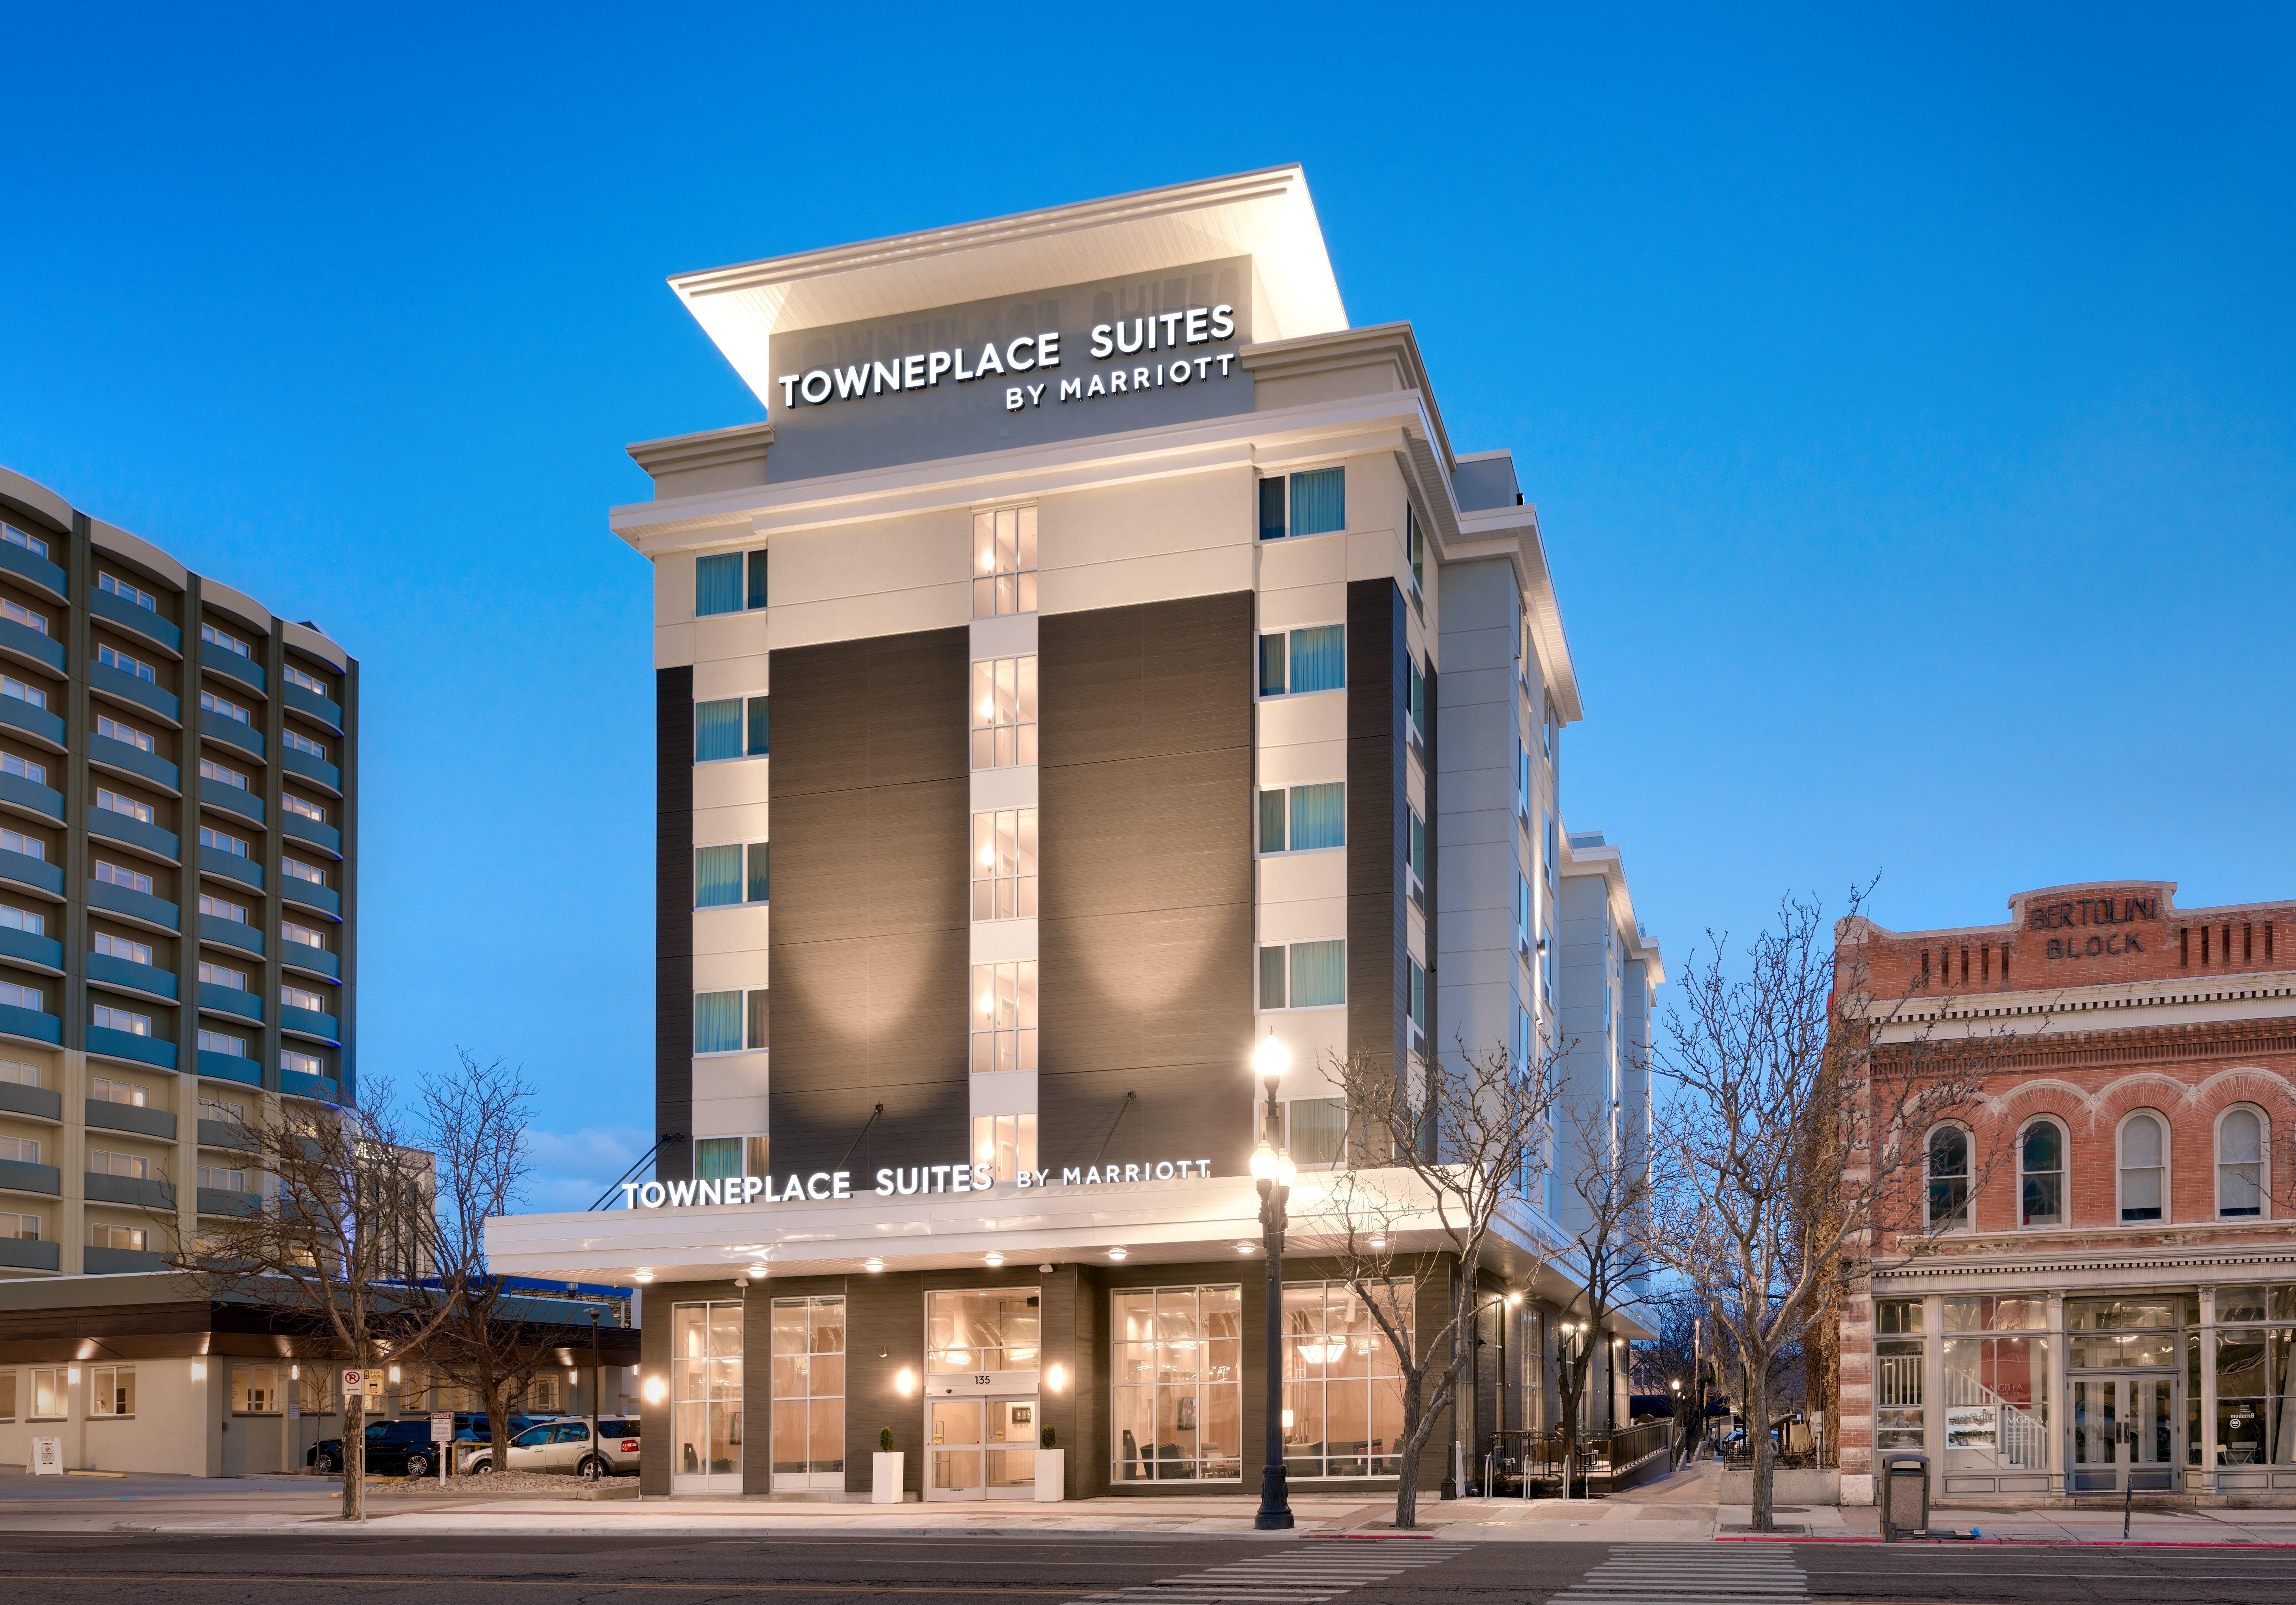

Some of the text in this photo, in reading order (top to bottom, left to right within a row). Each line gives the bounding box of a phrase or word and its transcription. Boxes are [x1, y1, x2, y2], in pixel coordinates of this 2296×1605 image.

[778, 304, 1234, 407] TOWNEPLACE SUITES
[1006, 353, 1235, 411] BY MARRIOTT
[2032, 898, 2156, 930] BERTOLINI
[2048, 932, 2144, 959] BLOCK
[622, 1159, 1211, 1209] TOWNEPLACE SUITES BY MARRIOTT
[975, 1376, 990, 1384] 135
[2007, 1416, 2044, 1424] MGB+A
